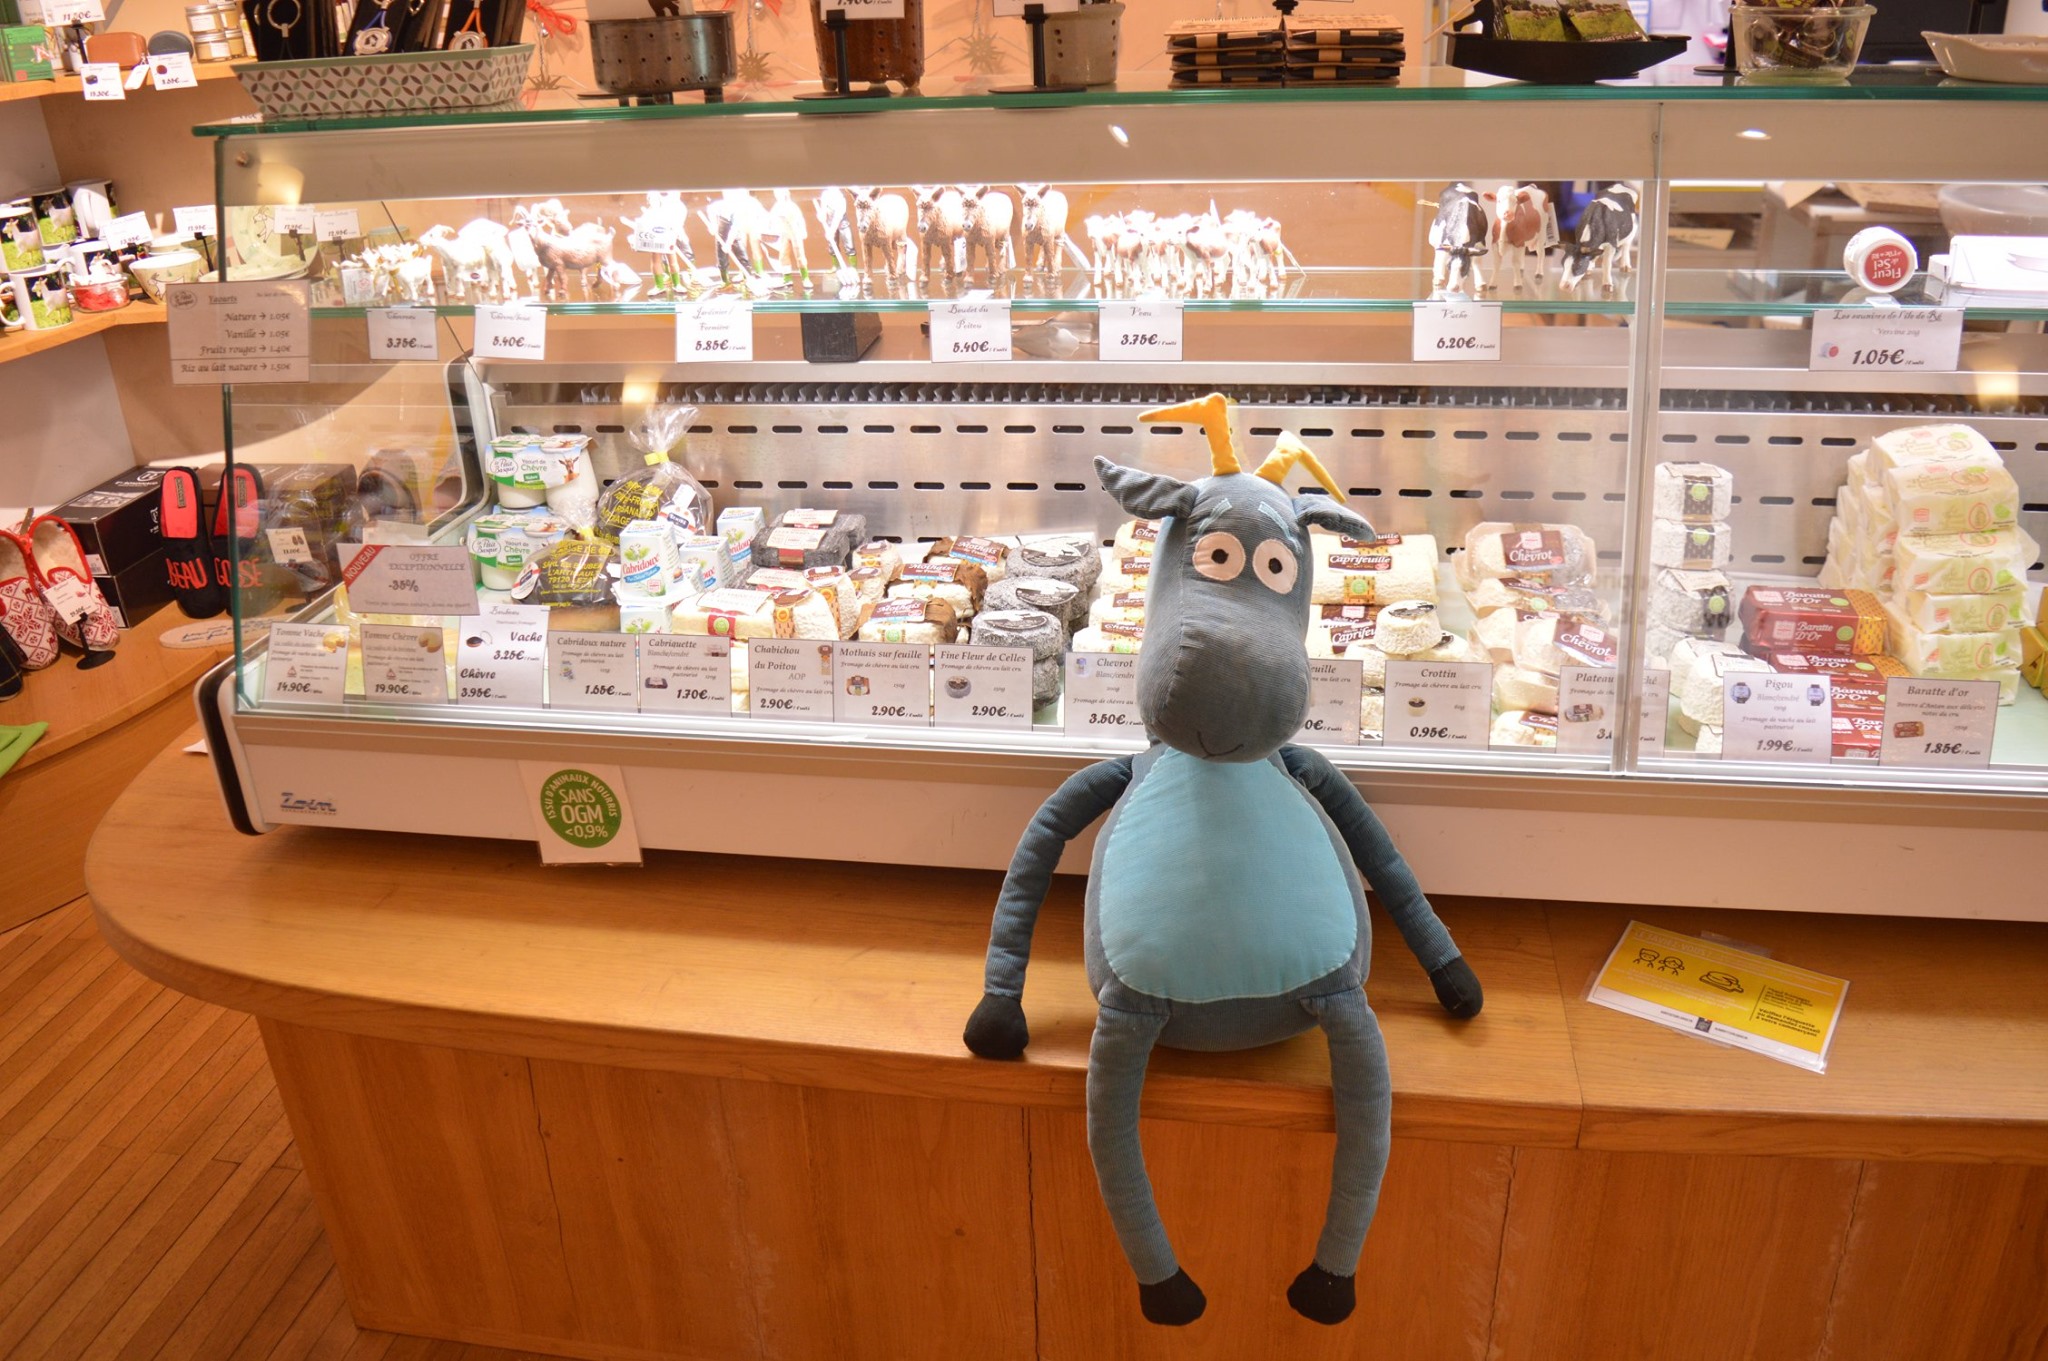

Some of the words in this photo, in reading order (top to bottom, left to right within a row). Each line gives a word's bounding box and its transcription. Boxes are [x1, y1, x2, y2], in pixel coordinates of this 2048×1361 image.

[1873, 257, 1891, 271] Sel
[1872, 267, 1901, 280] Fleur
[224, 312, 257, 321] Nature
[269, 312, 291, 320] 1.05€
[1130, 306, 1152, 317] Veau
[1441, 308, 1468, 319] Vache
[1833, 310, 1850, 320] Les
[1887, 310, 1896, 320] de
[1916, 310, 1926, 320] de
[225, 329, 257, 338] Vanille
[269, 330, 290, 338] 1.05€
[386, 337, 417, 348] 3.75€
[492, 336, 525, 348] 5.40€
[695, 339, 729, 351] 5.85€
[1121, 333, 1158, 346] 3.75€
[1436, 336, 1476, 349] 6.20€
[199, 345, 227, 356] Fruits
[229, 346, 257, 356] rouges
[270, 345, 291, 353] 1.40€
[953, 341, 989, 353] 5.40€
[1852, 349, 1905, 365] 1.05€
[181, 364, 195, 373] Riz
[211, 363, 226, 372] lait
[229, 364, 258, 372] nature
[270, 364, 291, 372] 1.50€
[521, 464, 547, 472] Chèvre
[504, 546, 531, 554] Chèvre
[1509, 549, 1552, 562] Chevrot
[409, 553, 439, 561] OFFRE
[1329, 555, 1391, 566] Caprifeuille
[346, 546, 376, 580] NOUVEAU
[389, 563, 465, 571] EXCEPTIONNELLE
[622, 554, 659, 575] Cabridoux
[166, 557, 208, 590] BEAU
[214, 557, 264, 588] GOSE
[389, 580, 419, 592] -35%
[1783, 591, 1831, 599] Baratte
[1797, 621, 1834, 632] Baratte
[275, 628, 302, 637] Tomme
[303, 629, 325, 638] Vache
[364, 630, 391, 640] Tomme
[392, 631, 418, 641] Chèvre
[510, 631, 543, 642] Vache
[1795, 631, 1822, 641] D'Or
[557, 637, 598, 647] Cabridoux
[600, 638, 627, 648] nature
[648, 638, 697, 650] Cabriquette
[1561, 633, 1611, 656] Chevrot
[493, 650, 525, 661] 3.25€
[754, 645, 800, 655] Chabichou
[840, 648, 875, 658] Mothais
[892, 650, 922, 661] feuille
[941, 651, 959, 660] Fine
[962, 652, 985, 661] Fleur
[987, 652, 997, 661] de
[999, 653, 1026, 662] Celles
[1807, 655, 1856, 663] Baratte
[754, 661, 766, 670] du
[767, 661, 797, 671] Poitou
[1097, 658, 1133, 668] Chevrot
[1810, 661, 1847, 669] D'Or
[460, 667, 496, 679] Chèvre
[788, 672, 806, 681] AOP
[1421, 669, 1456, 678] Crottin
[1575, 673, 1614, 683] Plateau
[277, 681, 311, 692] 14.90€
[375, 684, 409, 695] 19.90€
[1765, 678, 1793, 690] Pigou
[460, 687, 491, 698] 3.95€
[585, 684, 615, 696] 1.65€
[676, 689, 708, 700] 1.70€
[1831, 686, 1879, 695] Baratte
[1907, 685, 1946, 697] Baratte
[1948, 685, 1969, 697] d'or
[760, 698, 793, 710] 2.90€
[871, 705, 906, 717] 2.90€
[972, 705, 1006, 717] 2.90€
[1089, 713, 1126, 725] 3.50€
[1410, 727, 1448, 739] 0.95€
[1755, 739, 1793, 752] 1.99€
[1923, 742, 1962, 755] 1.85€
[545, 774, 589, 798] D'ANIMAUX
[559, 788, 595, 803] SANS
[590, 780, 617, 817] NOURRIS
[545, 798, 556, 819] ISSU
[560, 804, 604, 824] OGM
[565, 825, 608, 839] <0,9%
